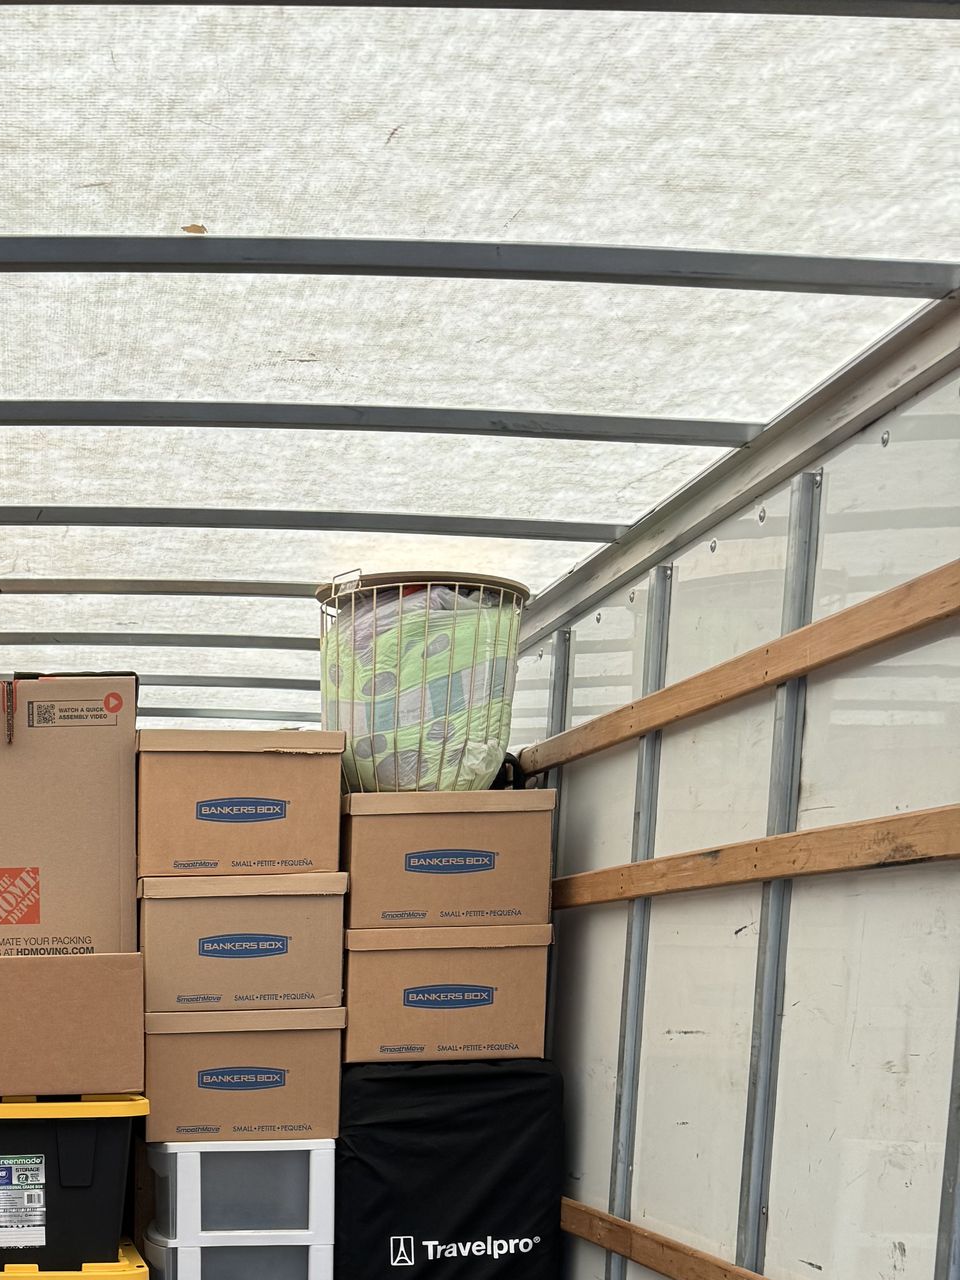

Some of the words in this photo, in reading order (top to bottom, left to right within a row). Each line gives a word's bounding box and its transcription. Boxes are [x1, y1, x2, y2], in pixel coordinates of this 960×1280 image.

[201, 806, 256, 815] BANKERS
[173, 859, 220, 869] SmoothMove
[410, 858, 465, 866] BANKERS
[465, 857, 490, 865] BOX
[7, 888, 40, 924] DEPOT
[381, 910, 428, 919] SmoothMove
[23, 937, 50, 946] YOUR
[51, 936, 92, 945] PACKING
[204, 942, 258, 950] BANKERS
[259, 941, 284, 949] BOX
[16, 947, 95, 956] HDMOVING.COM
[409, 993, 463, 1001] BANKERS
[464, 992, 488, 1000] BOX
[203, 1075, 256, 1083] BANKERS
[257, 1074, 281, 1082] BOX
[176, 1125, 221, 1134] SmoothMove
[422, 1236, 534, 1260] Travelpro
